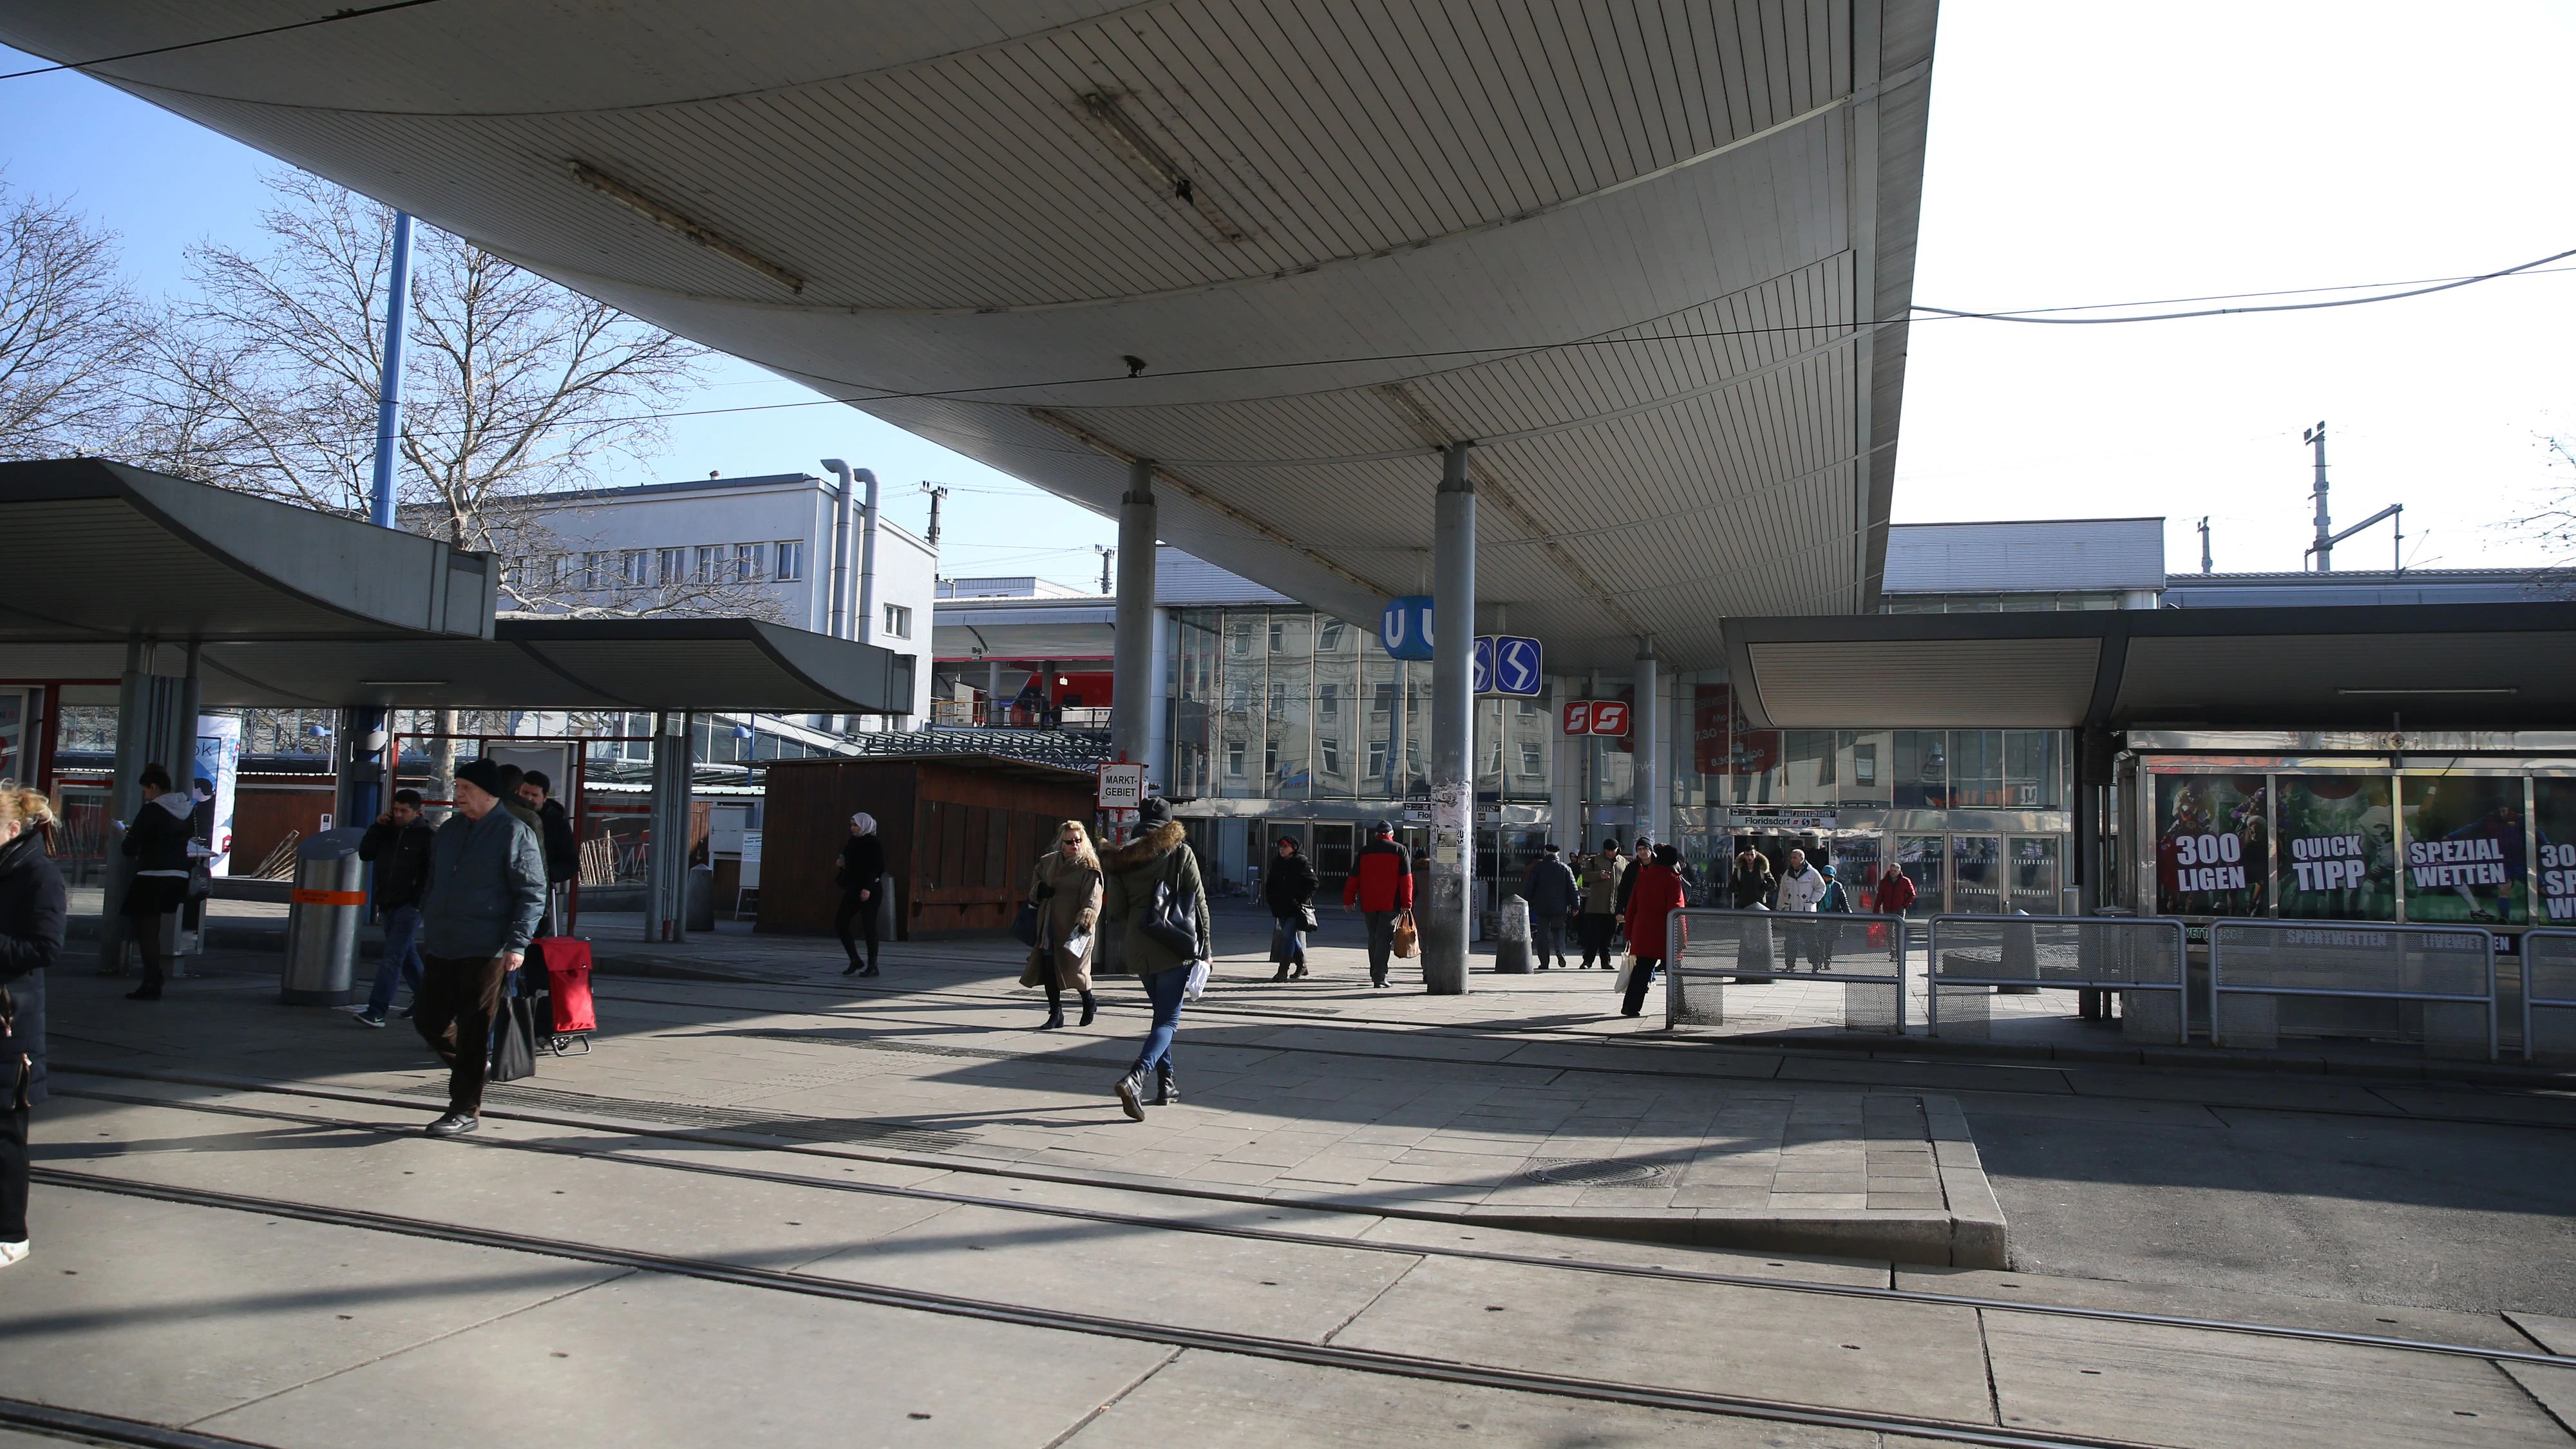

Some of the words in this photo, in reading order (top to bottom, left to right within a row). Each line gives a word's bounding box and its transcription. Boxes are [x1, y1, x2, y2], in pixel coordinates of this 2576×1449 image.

[1385, 609, 1405, 648] U
[1105, 787, 1136, 797] GEBIET
[1106, 775, 1138, 784] MARKT-
[1745, 817, 1791, 825] Floridsdorf
[2176, 833, 2240, 865] 300
[2292, 835, 2363, 860] QUICK
[2410, 838, 2504, 864] SPEZIAL
[2177, 866, 2246, 891] LIGEN
[2292, 860, 2365, 891] TIPP
[2412, 862, 2506, 887] WETTEN
